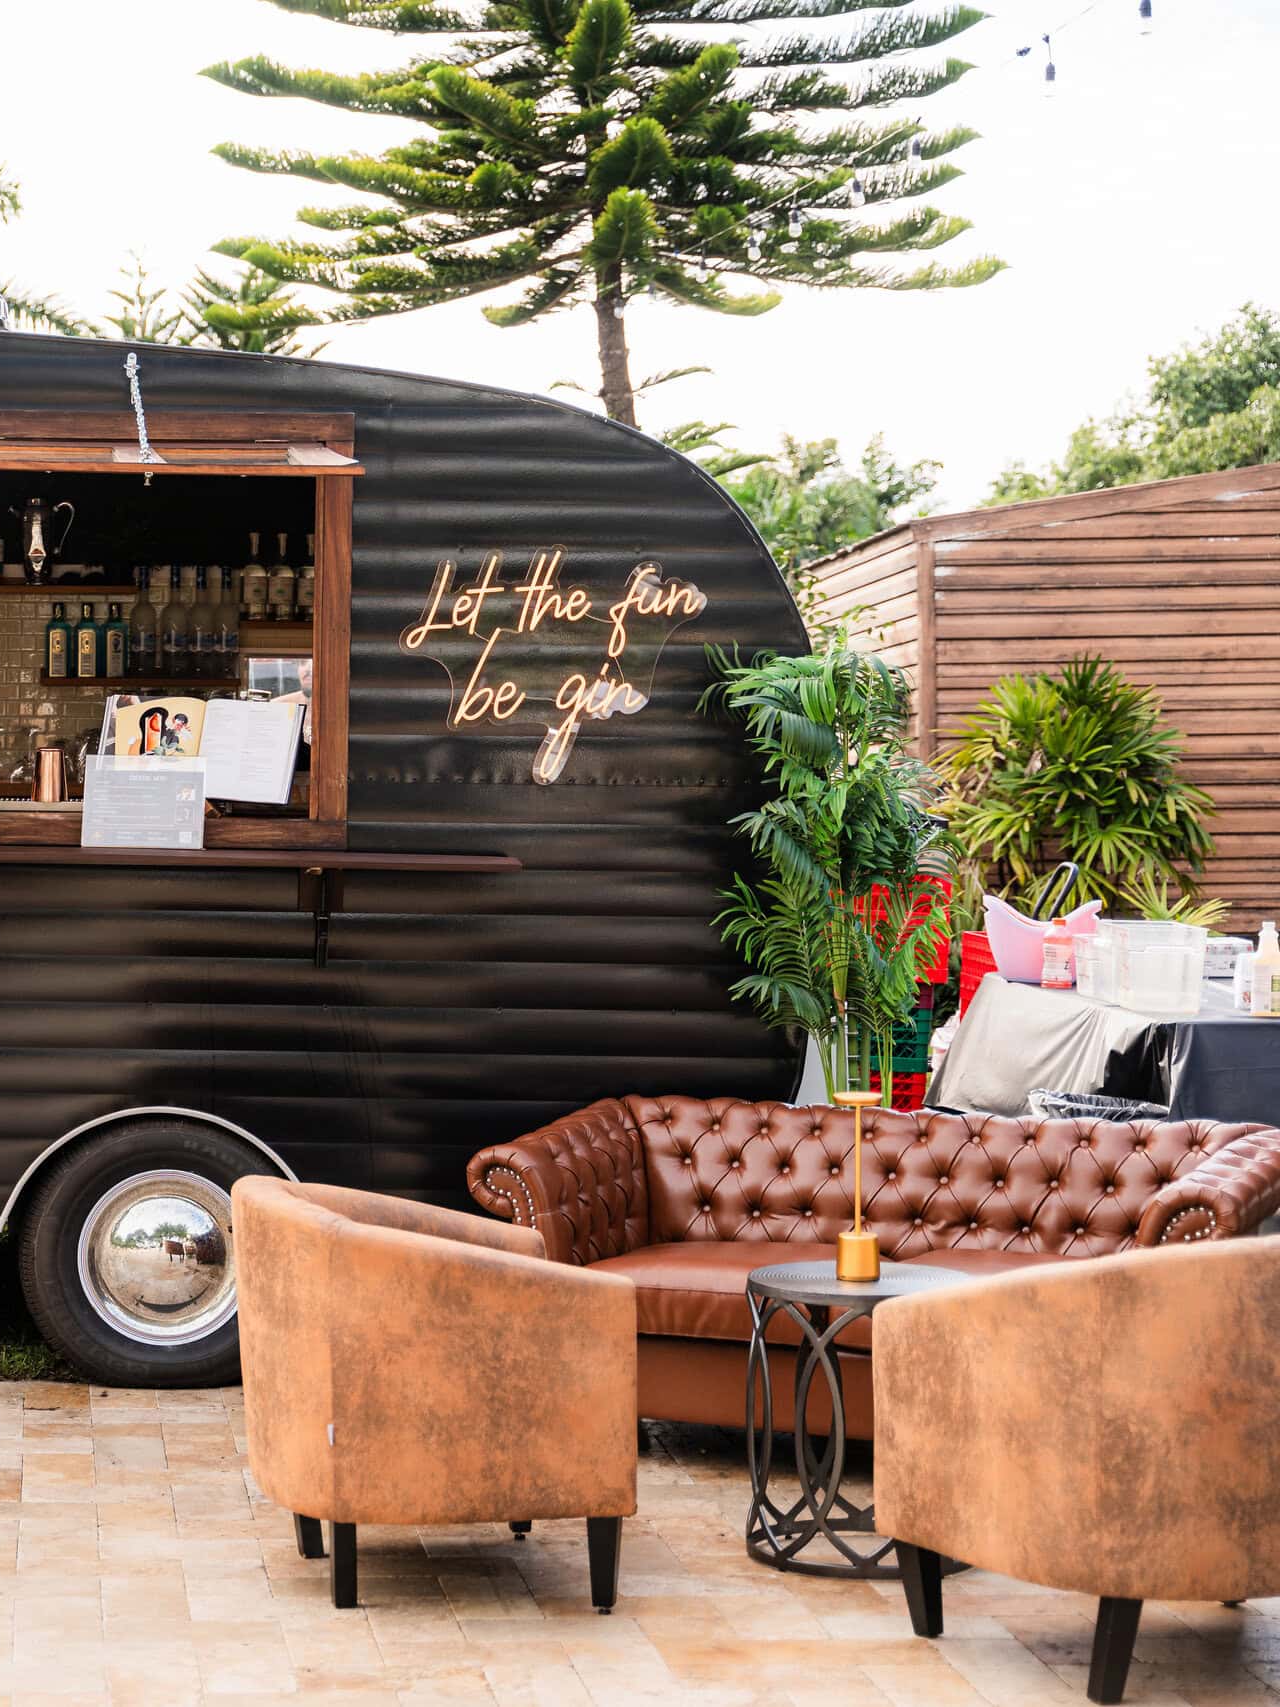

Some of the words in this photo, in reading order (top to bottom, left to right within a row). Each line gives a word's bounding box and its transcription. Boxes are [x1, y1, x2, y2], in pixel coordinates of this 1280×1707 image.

[406, 556, 505, 649] Let
[515, 550, 592, 633] the
[609, 567, 703, 658] fun
[453, 627, 526, 728] be
[540, 663, 644, 779] gin
